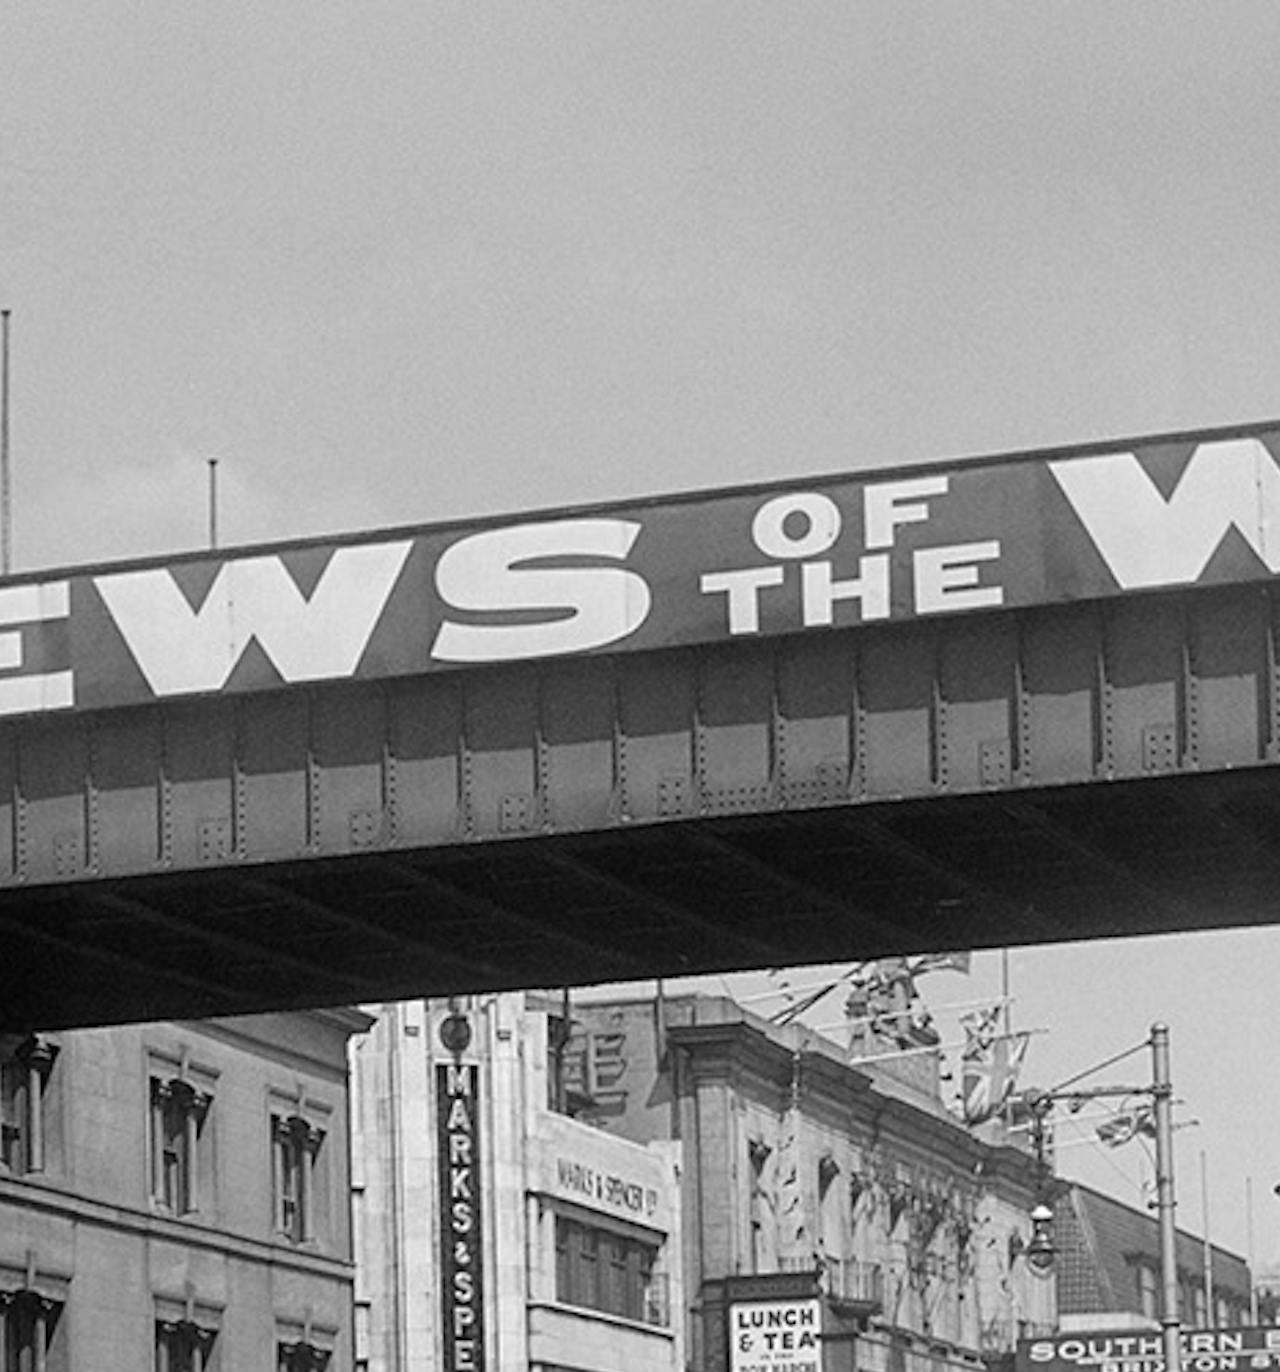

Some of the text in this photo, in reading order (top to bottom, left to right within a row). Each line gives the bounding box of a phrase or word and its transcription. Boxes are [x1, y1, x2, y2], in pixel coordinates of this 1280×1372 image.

[751, 477, 949, 560] OF
[700, 540, 1003, 635] THE
[738, 1308, 815, 1329] LUNCH
[739, 1331, 816, 1353] & TEA
